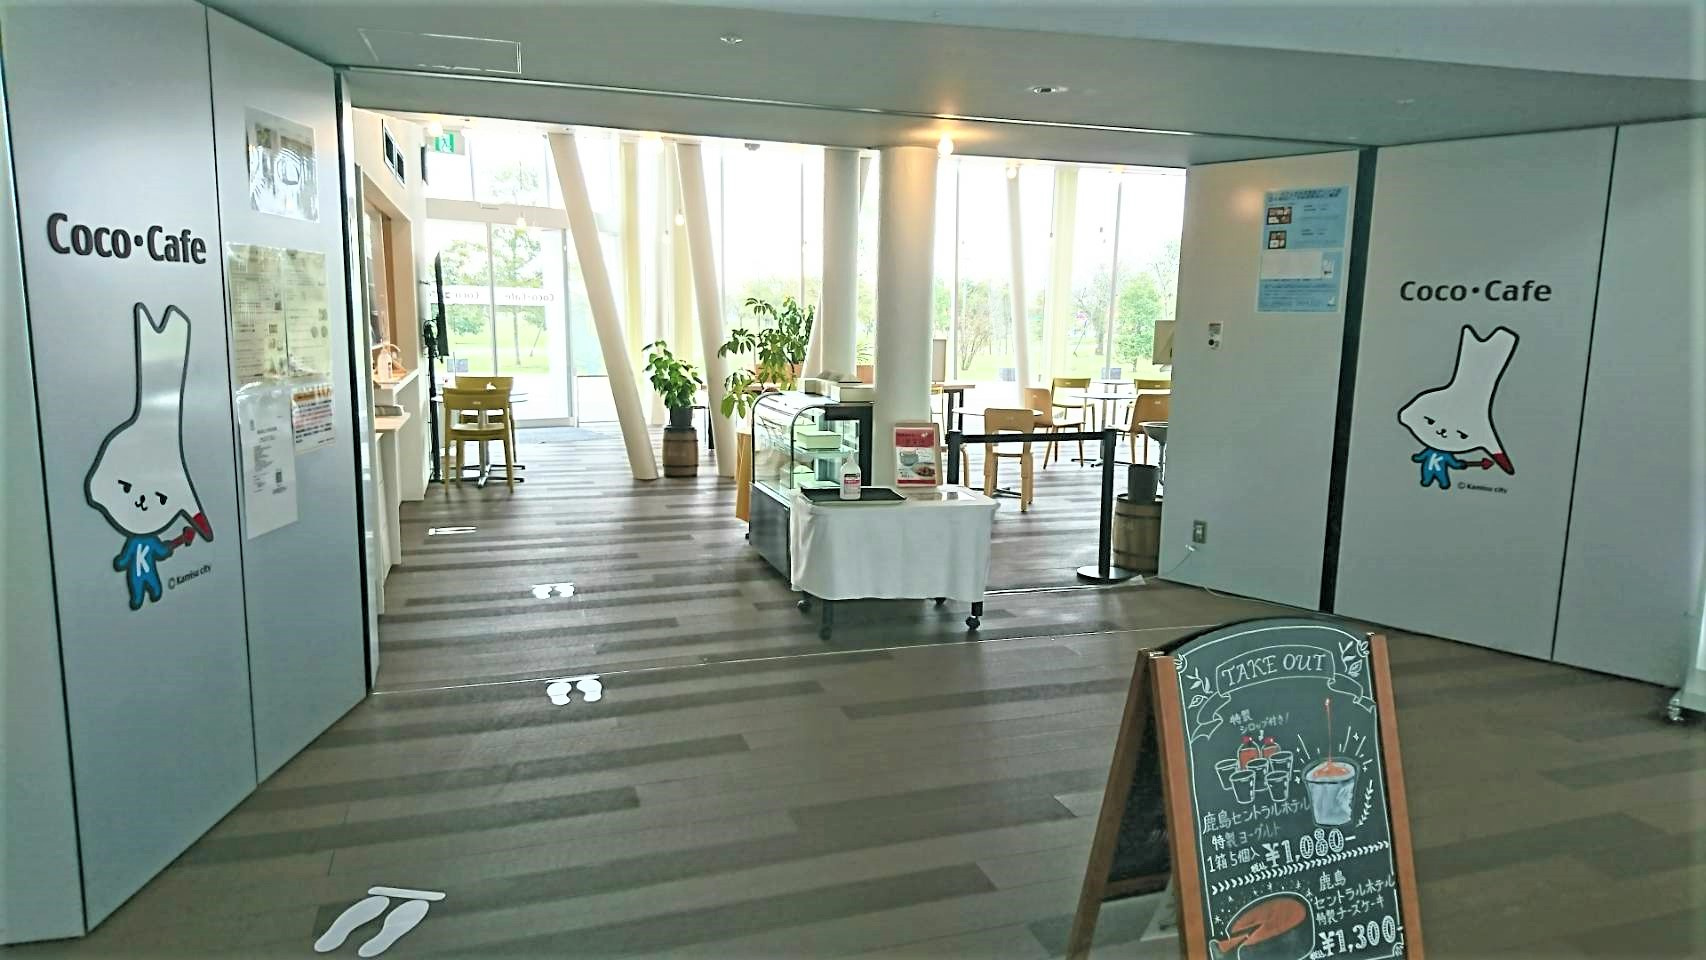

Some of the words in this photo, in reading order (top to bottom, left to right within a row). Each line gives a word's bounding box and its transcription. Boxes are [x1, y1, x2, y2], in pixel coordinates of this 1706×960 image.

[136, 544, 151, 577] K
[1221, 655, 1278, 687] TAKE
[1282, 653, 1326, 671] OUT
[1319, 869, 1346, 892] 鹿島
